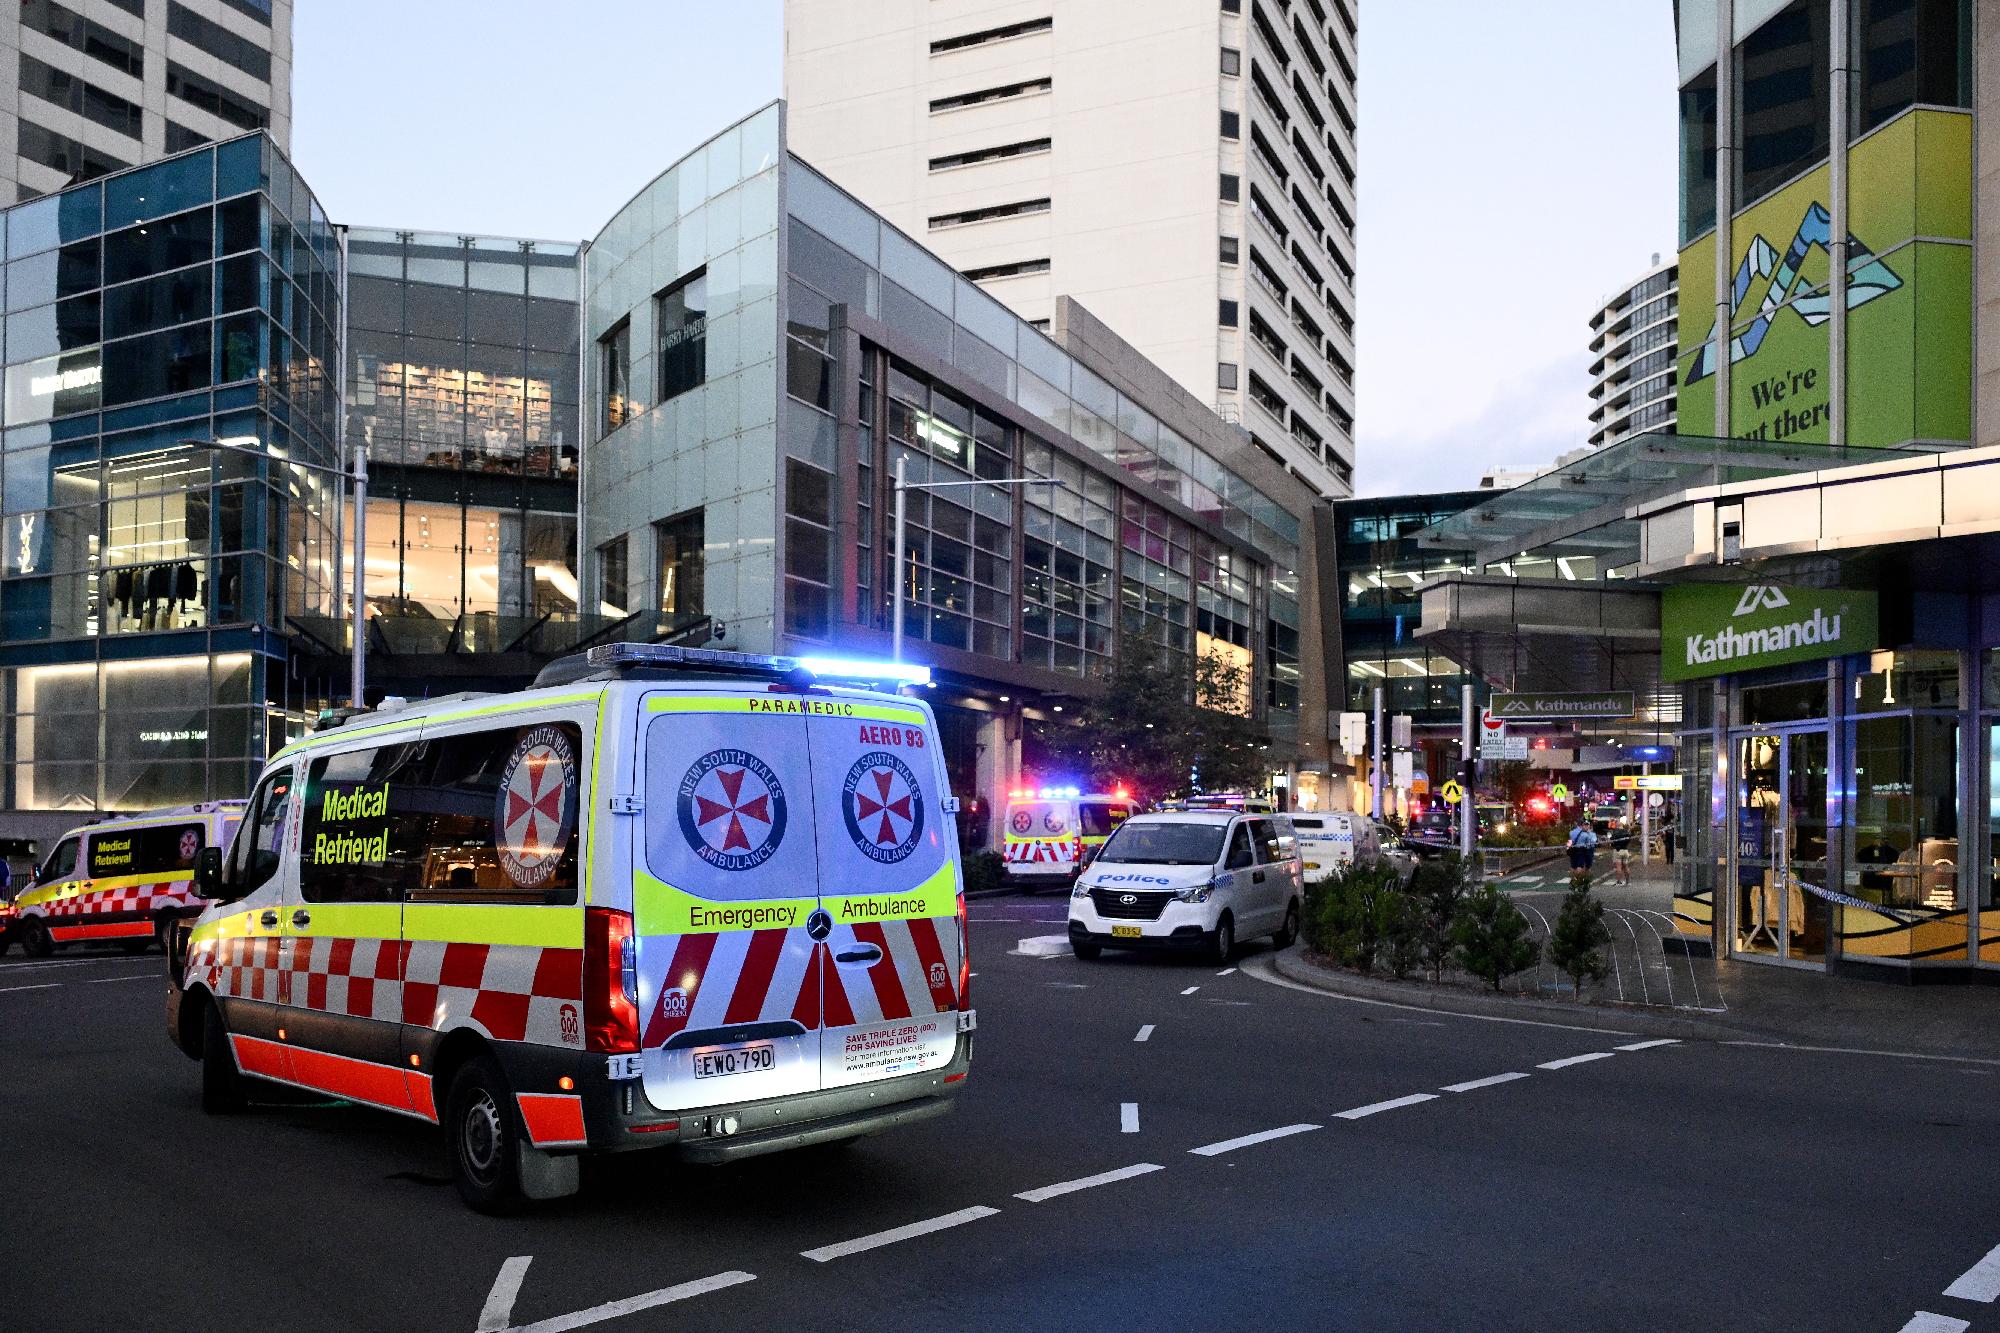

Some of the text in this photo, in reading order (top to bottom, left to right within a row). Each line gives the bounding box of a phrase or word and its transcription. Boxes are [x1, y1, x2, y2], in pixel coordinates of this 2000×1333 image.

[1752, 368, 1816, 409] We're
[1687, 608, 1840, 665] Kathmandu
[749, 698, 853, 716] PARAMEDIC
[1535, 699, 1622, 712] Kathmandu
[859, 725, 924, 748] AERO 93
[500, 727, 575, 791] NEW SOUTH WALES
[680, 751, 782, 799] NEW SOUTH WALES
[844, 754, 921, 800] NEW SOUTH WALES
[322, 782, 389, 822] Medical
[97, 838, 131, 853] Medical
[314, 827, 389, 865] Retrieval
[698, 841, 774, 869] AMBULANCE
[857, 838, 915, 861] AMBULANCE
[95, 852, 132, 866] Retrieval
[502, 853, 561, 885] AMBULANCE
[1097, 874, 1170, 885] Police
[690, 898, 926, 928] Emergency Ambulance
[931, 971, 945, 982] 000
[663, 997, 687, 1011] 000
[561, 1017, 578, 1034] 000
[846, 1023, 937, 1044] SAVE TRIPLE ZERO (000)
[845, 1035, 917, 1053] FOR SAVING LIVES
[845, 1055, 858, 1063] For
[877, 1047, 914, 1057] information
